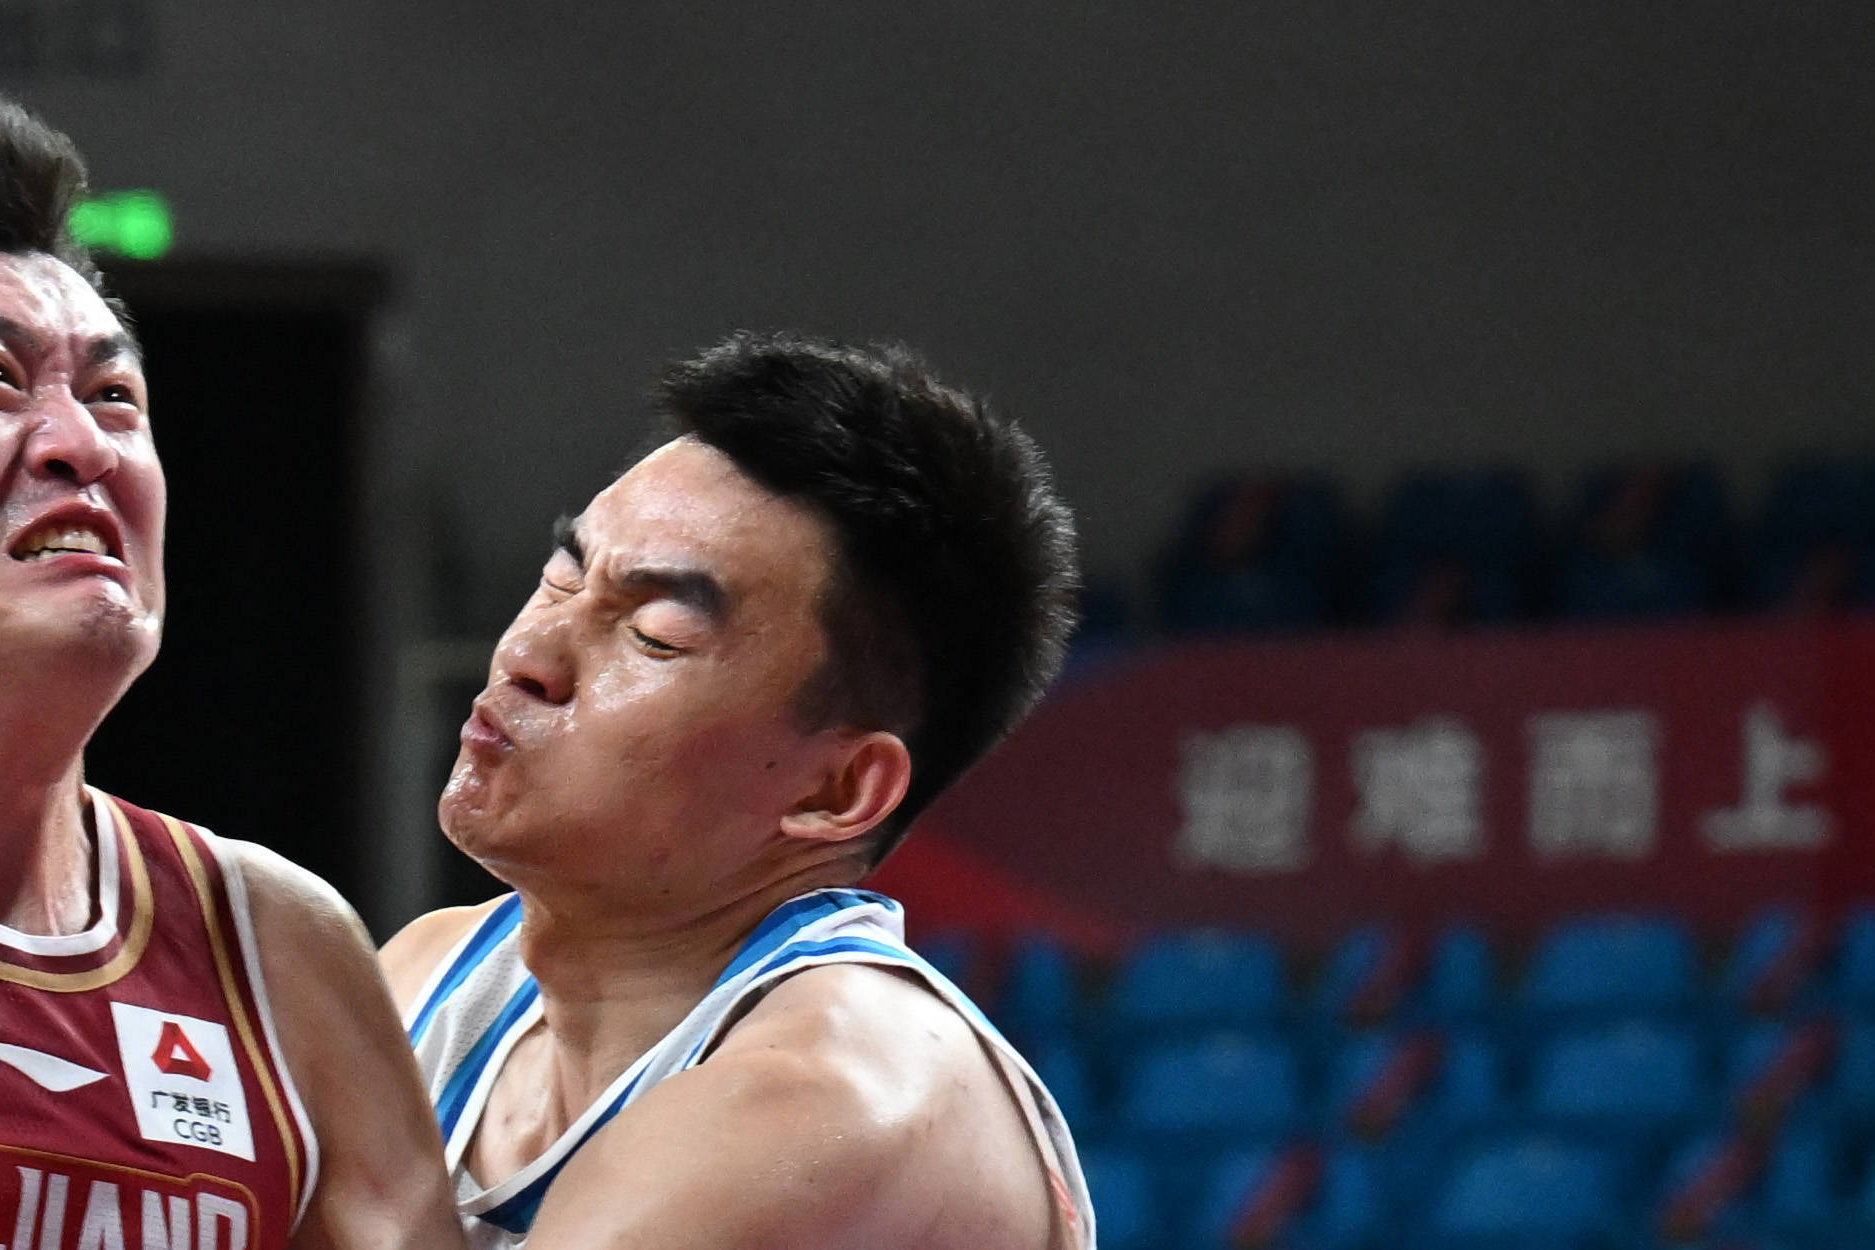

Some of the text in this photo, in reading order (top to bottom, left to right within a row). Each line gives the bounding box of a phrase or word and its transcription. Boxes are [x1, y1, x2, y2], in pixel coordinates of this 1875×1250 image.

[1172, 702, 1835, 872] 迎难而上
[151, 1090, 231, 1124] 广发银行
[174, 1118, 222, 1146] CGB
